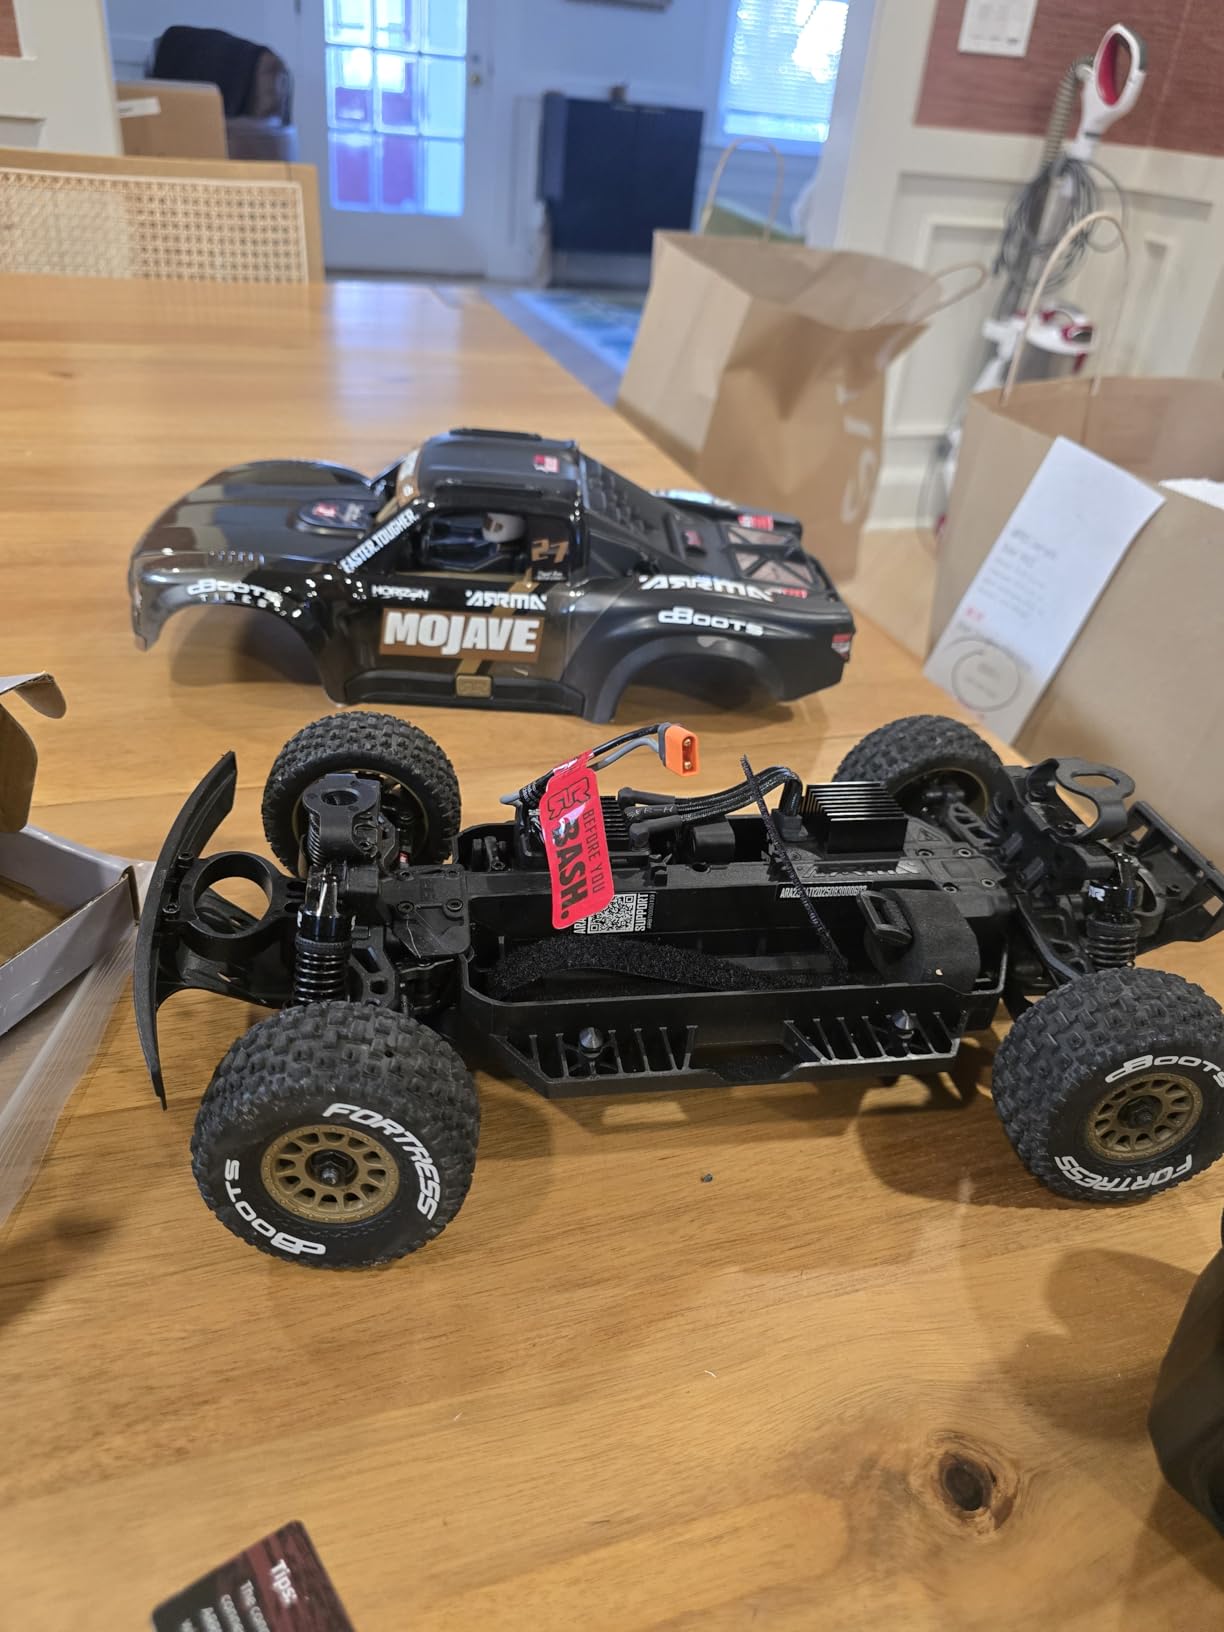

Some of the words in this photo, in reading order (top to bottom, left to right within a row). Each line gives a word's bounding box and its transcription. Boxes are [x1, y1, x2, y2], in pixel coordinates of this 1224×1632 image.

[384, 611, 540, 656] MOJAVE
[582, 807, 601, 861] BEFORE
[552, 817, 589, 919] BASH.
[590, 862, 605, 894] YOU
[635, 892, 649, 933] SUPPORT
[322, 1102, 441, 1221] FORTRESS
[1054, 1154, 1193, 1192] FORTRESS
